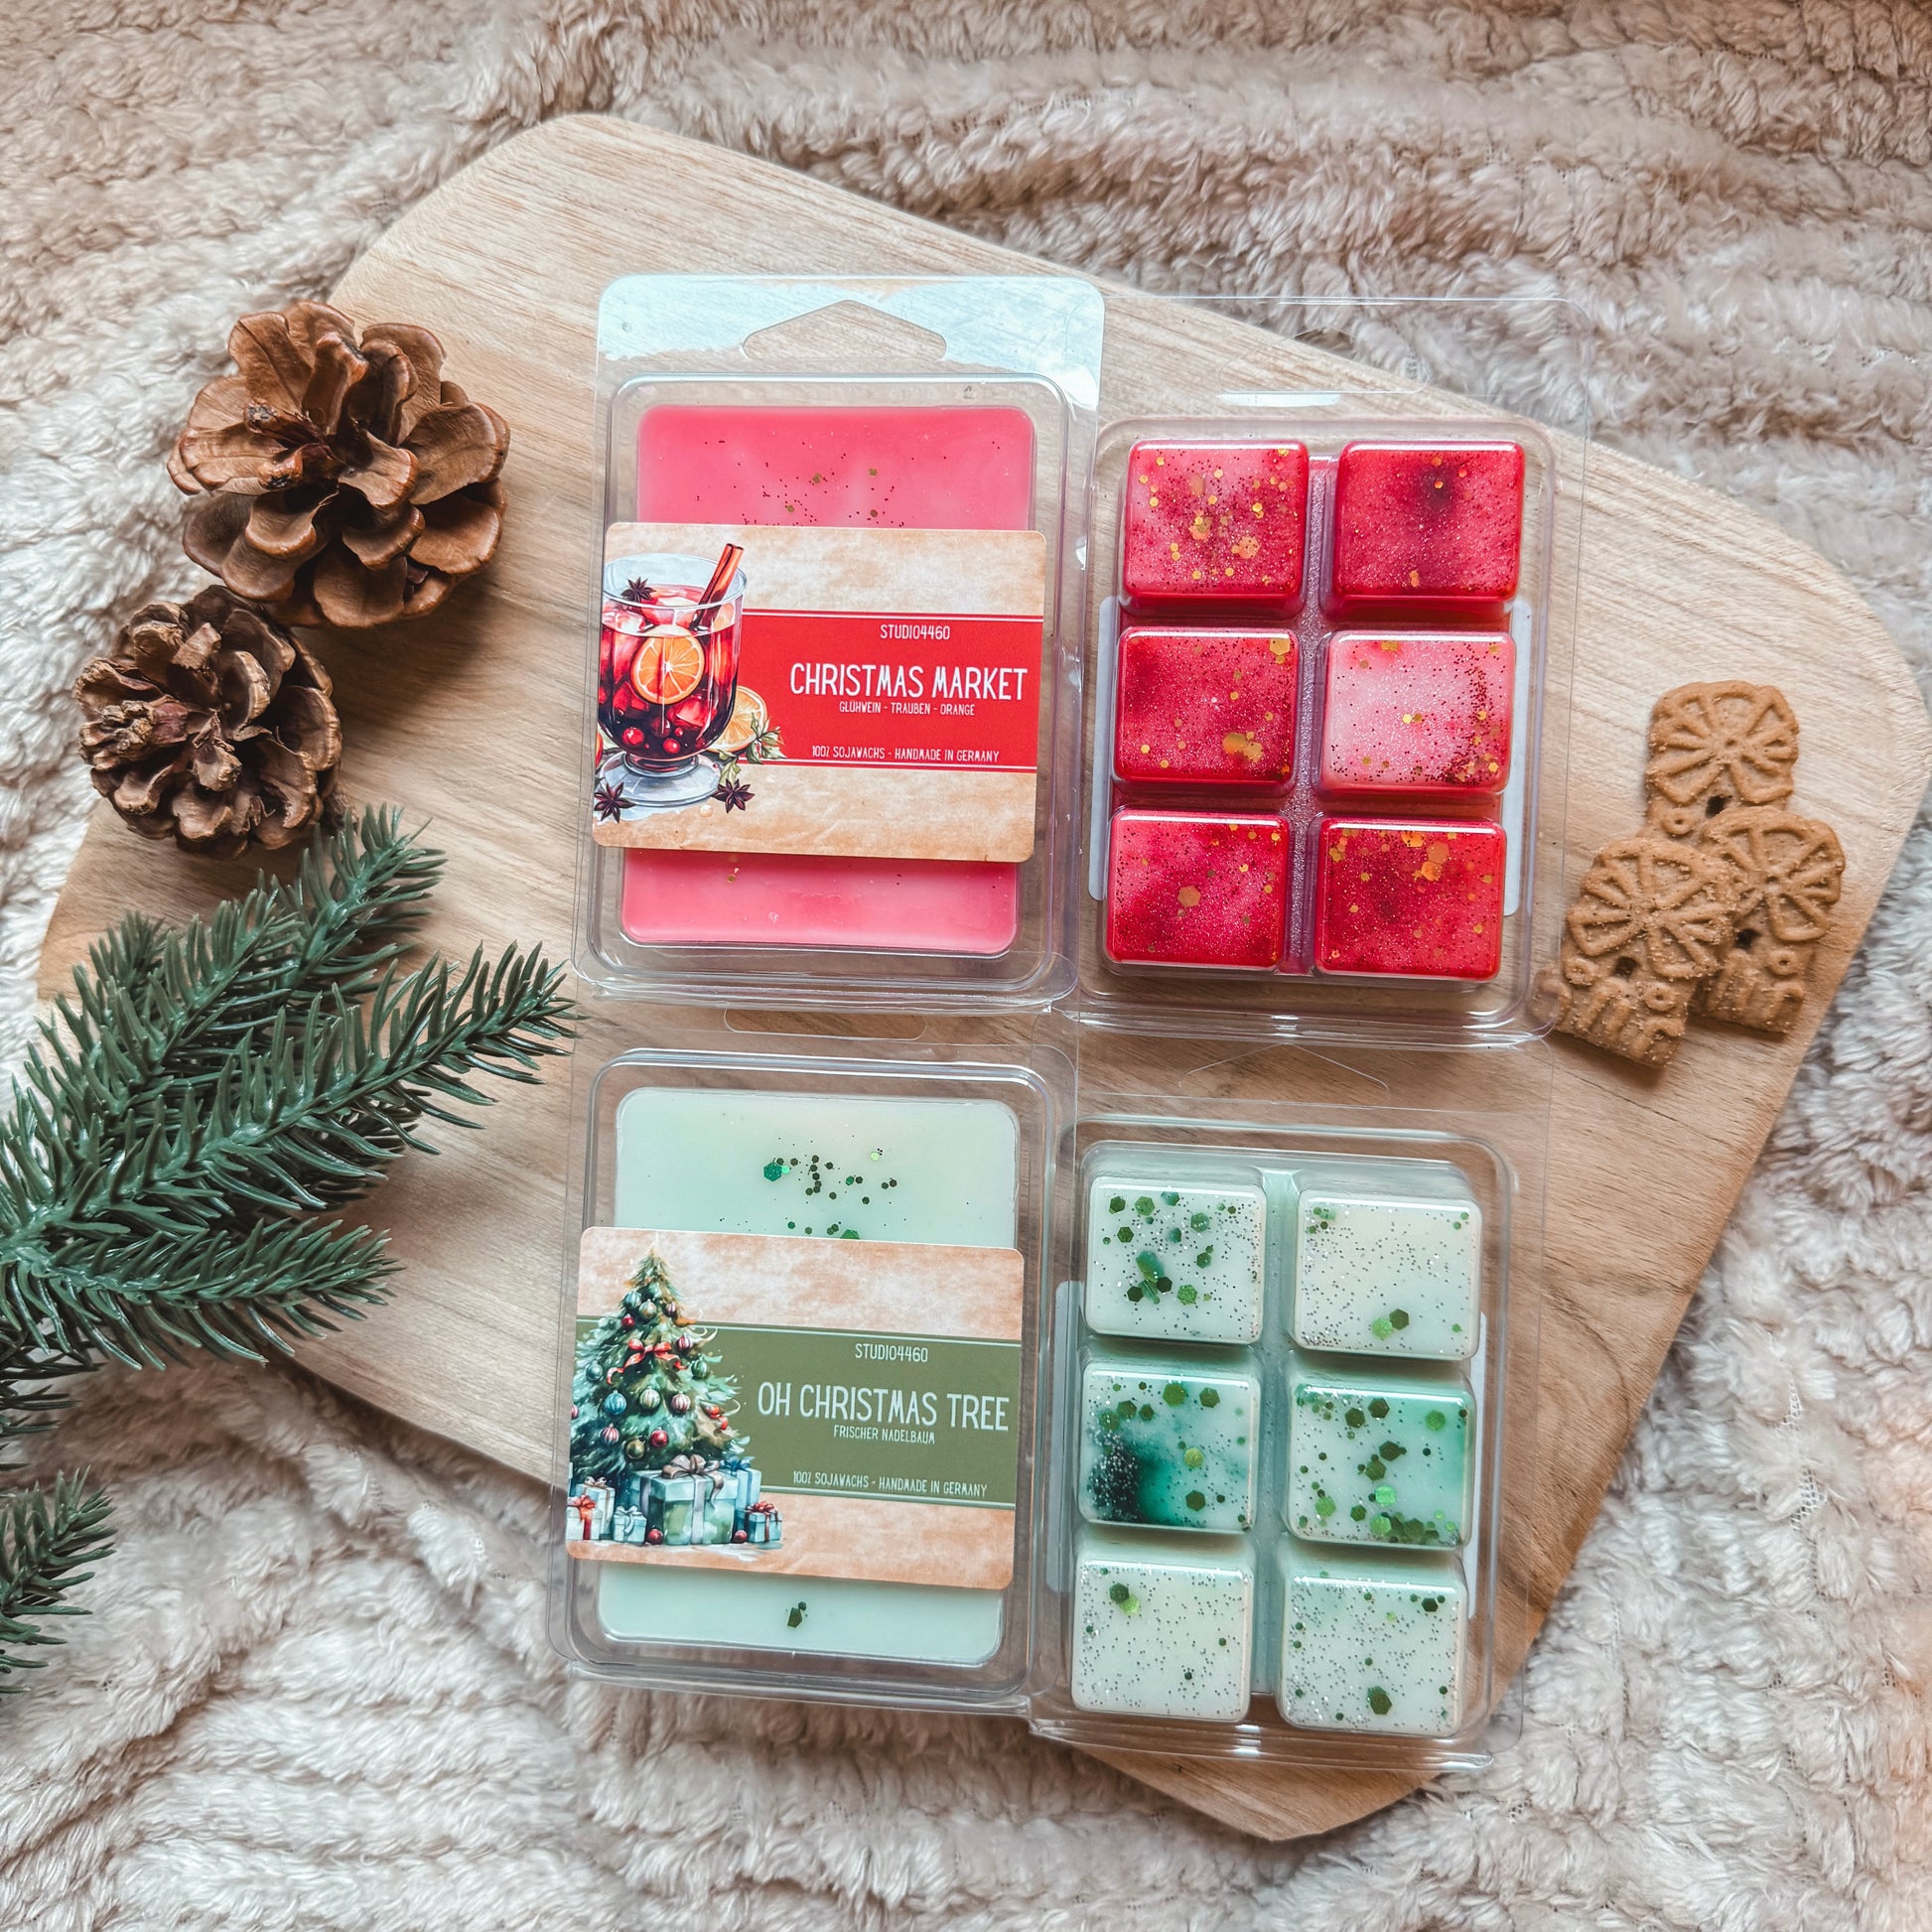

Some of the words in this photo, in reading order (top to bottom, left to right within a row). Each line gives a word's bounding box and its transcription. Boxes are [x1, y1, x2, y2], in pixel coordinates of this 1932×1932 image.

[880, 623, 951, 640] STUDIO4460
[789, 662, 924, 698] CHRISTMAS
[931, 666, 1029, 701] MARKET
[891, 702, 931, 715] TRAUBEN
[939, 703, 976, 716] ORANGE
[832, 746, 886, 760] SOJAWACHS
[895, 748, 941, 761] HANDMADE
[944, 749, 953, 761] IN
[956, 750, 1000, 762] GERMANY
[855, 1342, 929, 1363] STUDIO4460
[757, 1381, 792, 1418] OH
[799, 1383, 938, 1427] CHRISTMAS
[946, 1393, 1011, 1432] TREE
[833, 1424, 879, 1441] FRISCHER
[881, 1430, 935, 1446] NADELBAUM
[815, 1471, 870, 1489] SOJAWACHS
[879, 1476, 927, 1493] HANDMADE
[930, 1479, 940, 1495] IN
[943, 1481, 988, 1497] GERMANY
